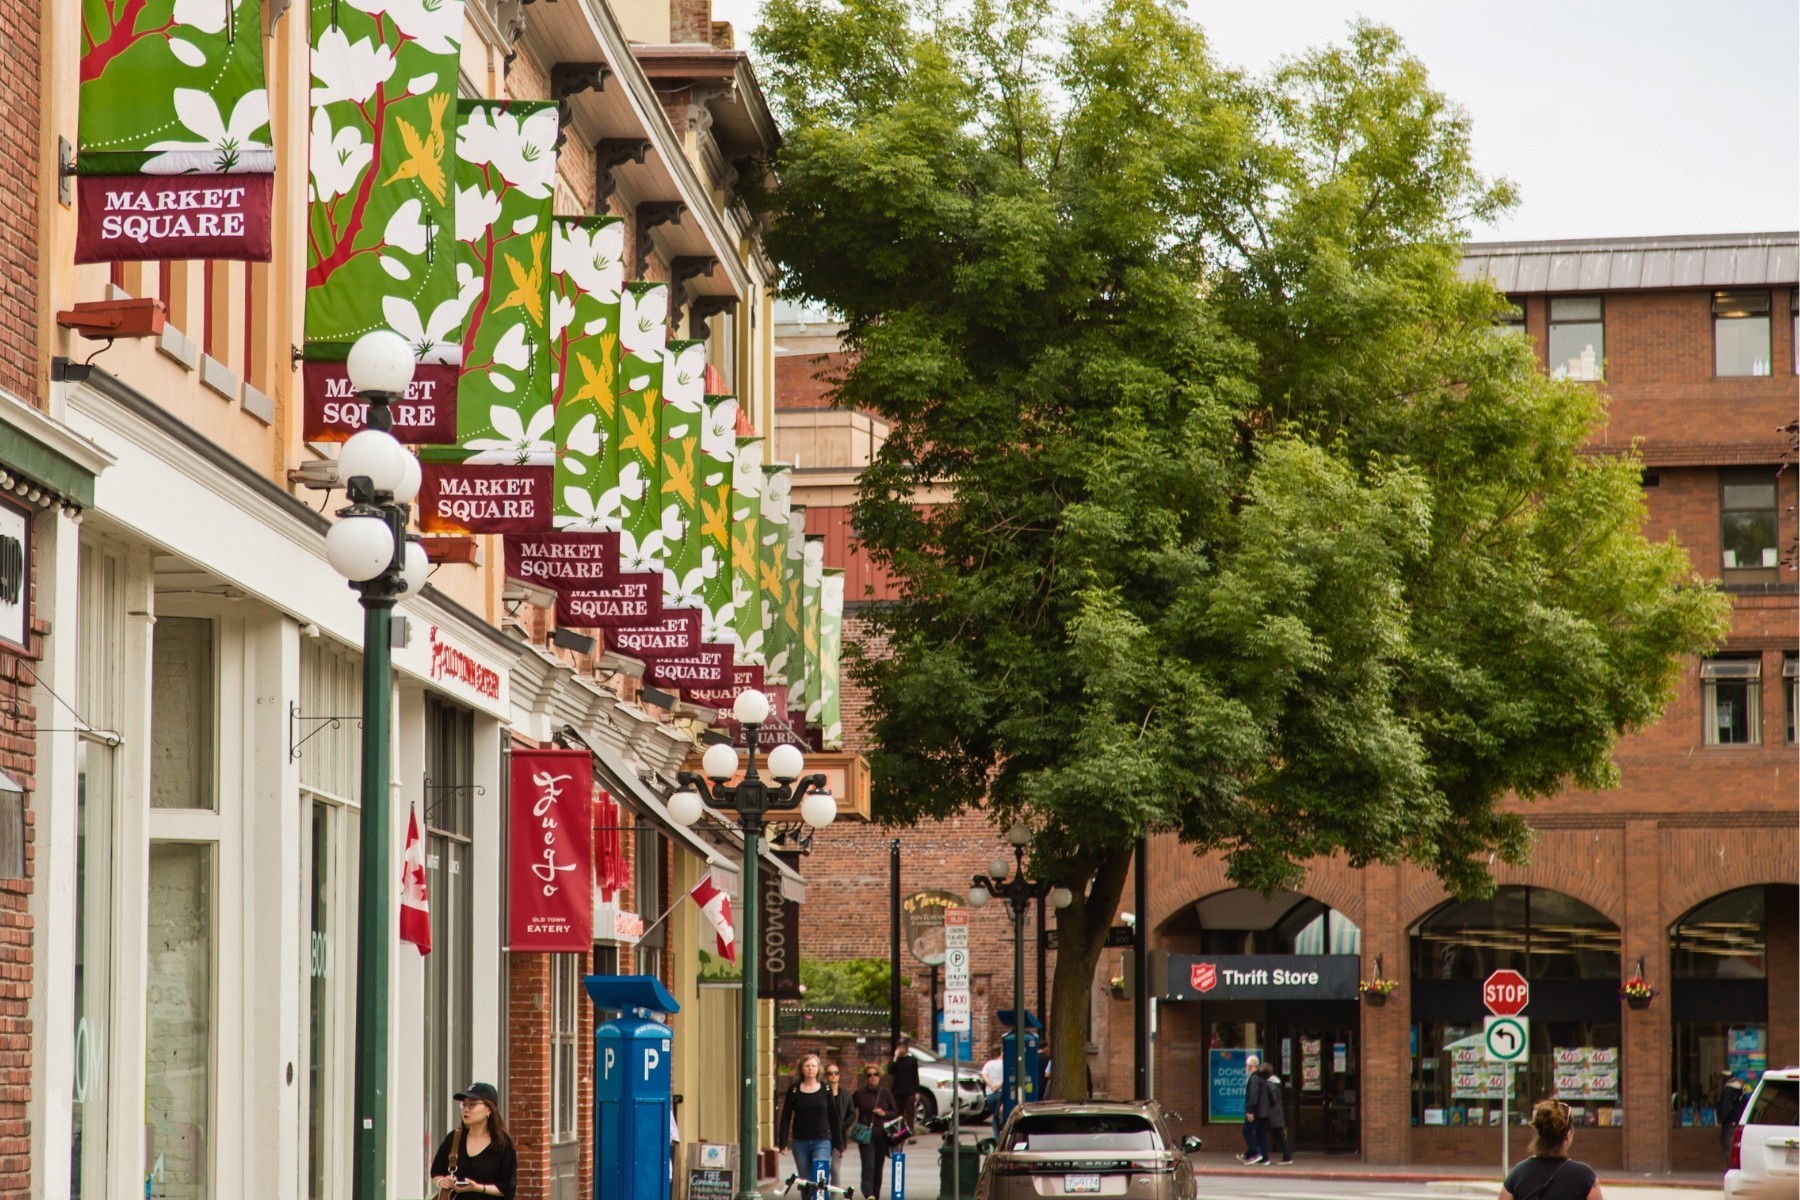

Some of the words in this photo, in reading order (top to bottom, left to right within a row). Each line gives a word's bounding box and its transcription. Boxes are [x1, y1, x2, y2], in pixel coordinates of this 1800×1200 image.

[104, 187, 245, 212] MARKET
[101, 213, 245, 243] SQUARE
[439, 478, 535, 496] MARKET
[438, 499, 535, 522] SQUARE
[521, 543, 603, 559] MARKET
[520, 560, 603, 579] SQUARE
[570, 600, 647, 618] SQUARE
[617, 634, 689, 650] SQUARE
[655, 665, 721, 680] SQUARE
[690, 686, 752, 700] SQUAR
[740, 732, 796, 744] SUARE
[532, 771, 577, 897] Fuego
[527, 925, 571, 933] EATERY
[1223, 970, 1268, 985] Thrift
[1273, 969, 1319, 985] Store
[948, 995, 968, 1005] TAXI
[1487, 984, 1527, 1003] STOP
[605, 1047, 615, 1081] P
[644, 1048, 660, 1081] P
[1218, 1067, 1248, 1077] DONO
[1213, 1078, 1246, 1087] WELCO
[1219, 1088, 1246, 1096] CENT
